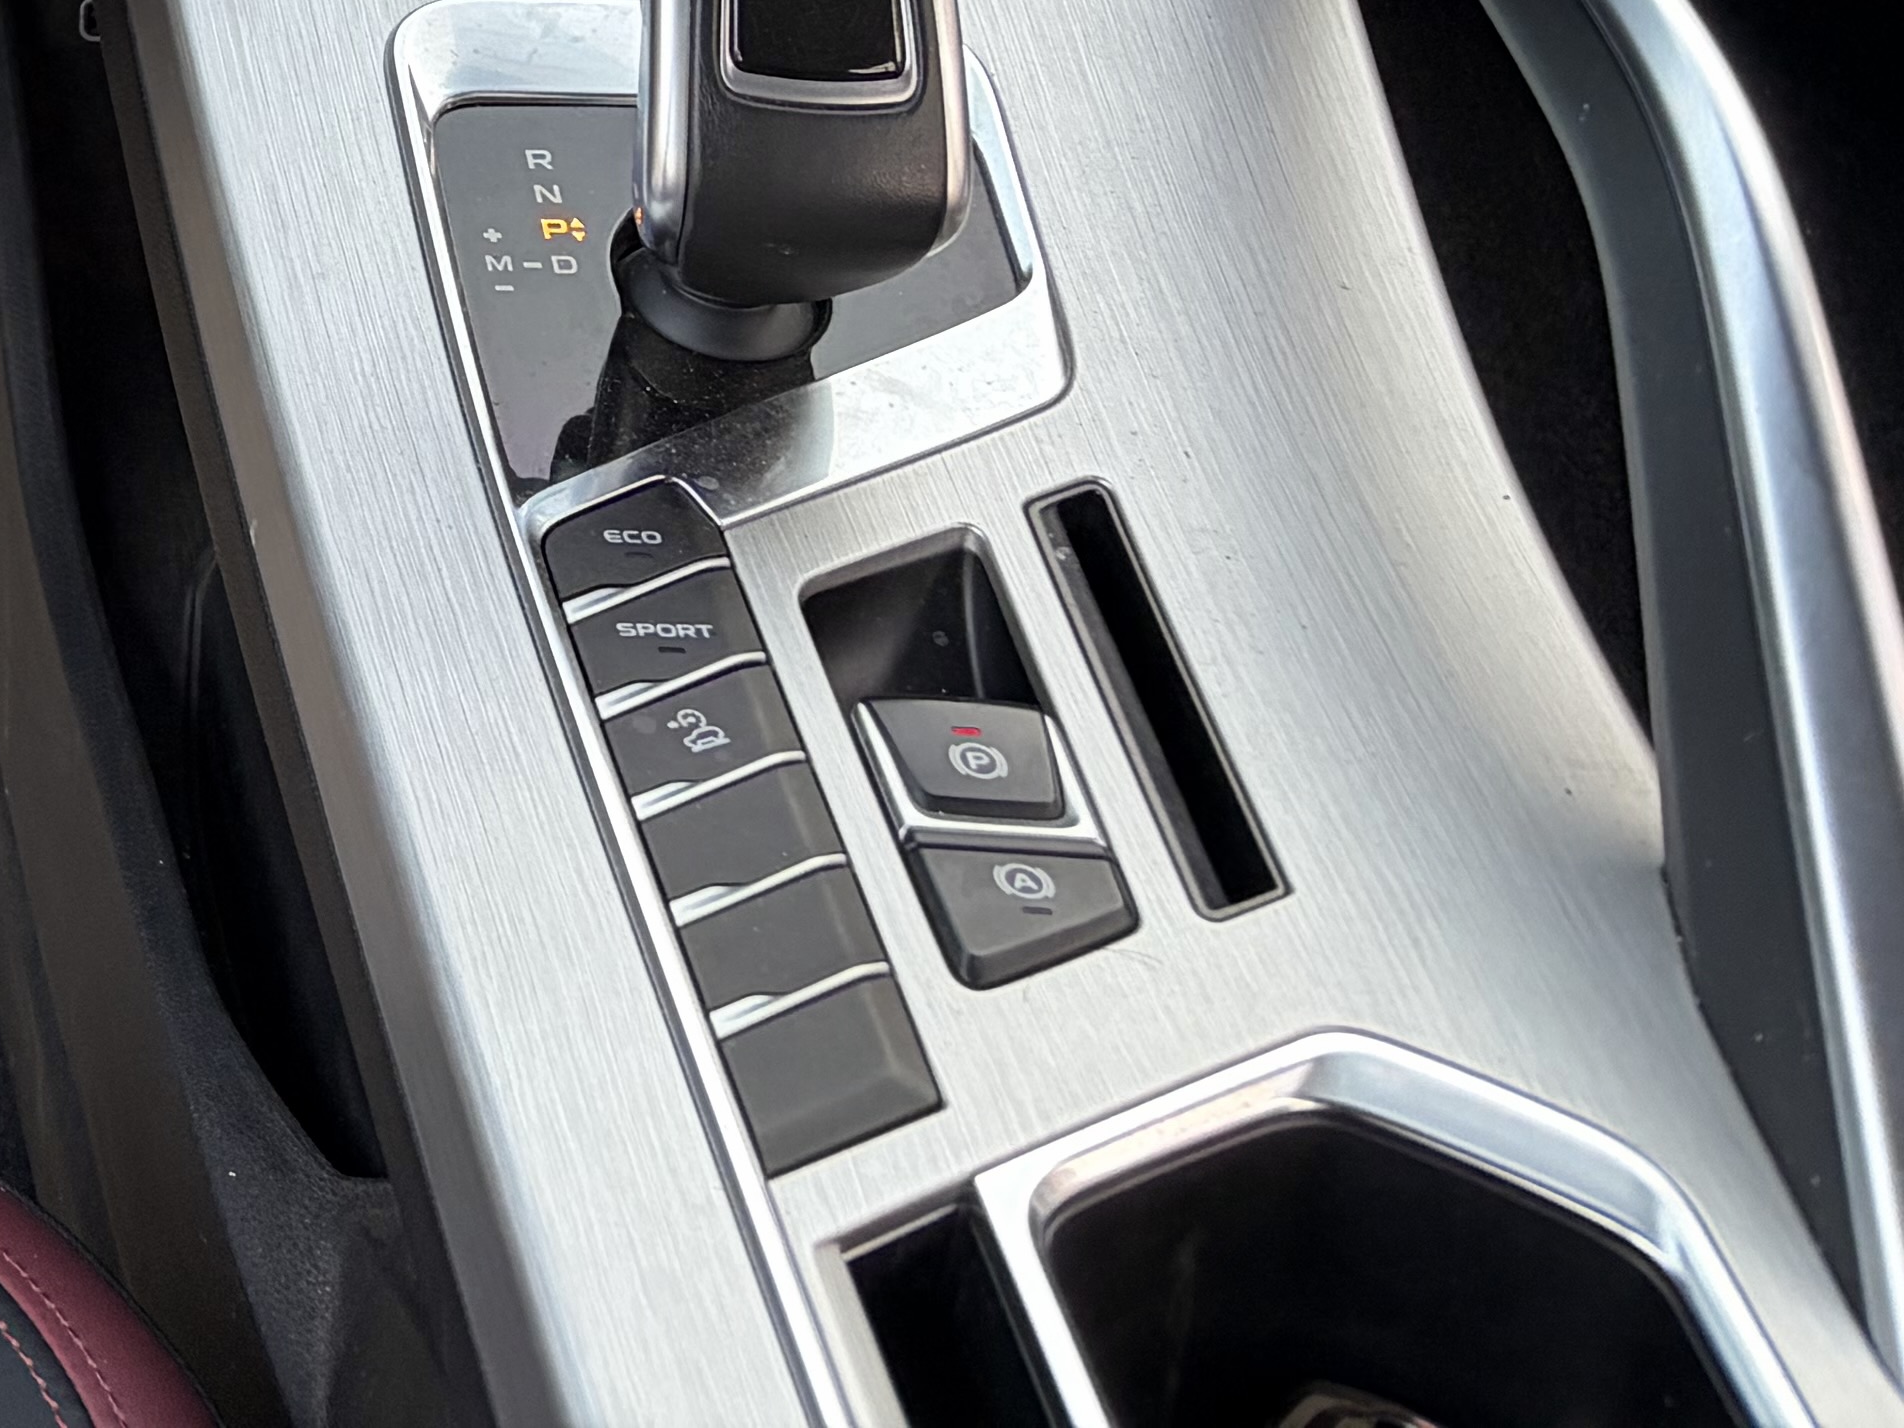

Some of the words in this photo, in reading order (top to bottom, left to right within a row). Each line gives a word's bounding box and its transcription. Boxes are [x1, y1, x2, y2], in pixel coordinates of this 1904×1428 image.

[525, 149, 553, 170] R
[533, 184, 563, 205] N
[540, 218, 569, 241] P
[484, 254, 514, 273] M
[553, 254, 579, 275] D
[603, 529, 662, 544] ECO
[616, 622, 713, 638] SPORT
